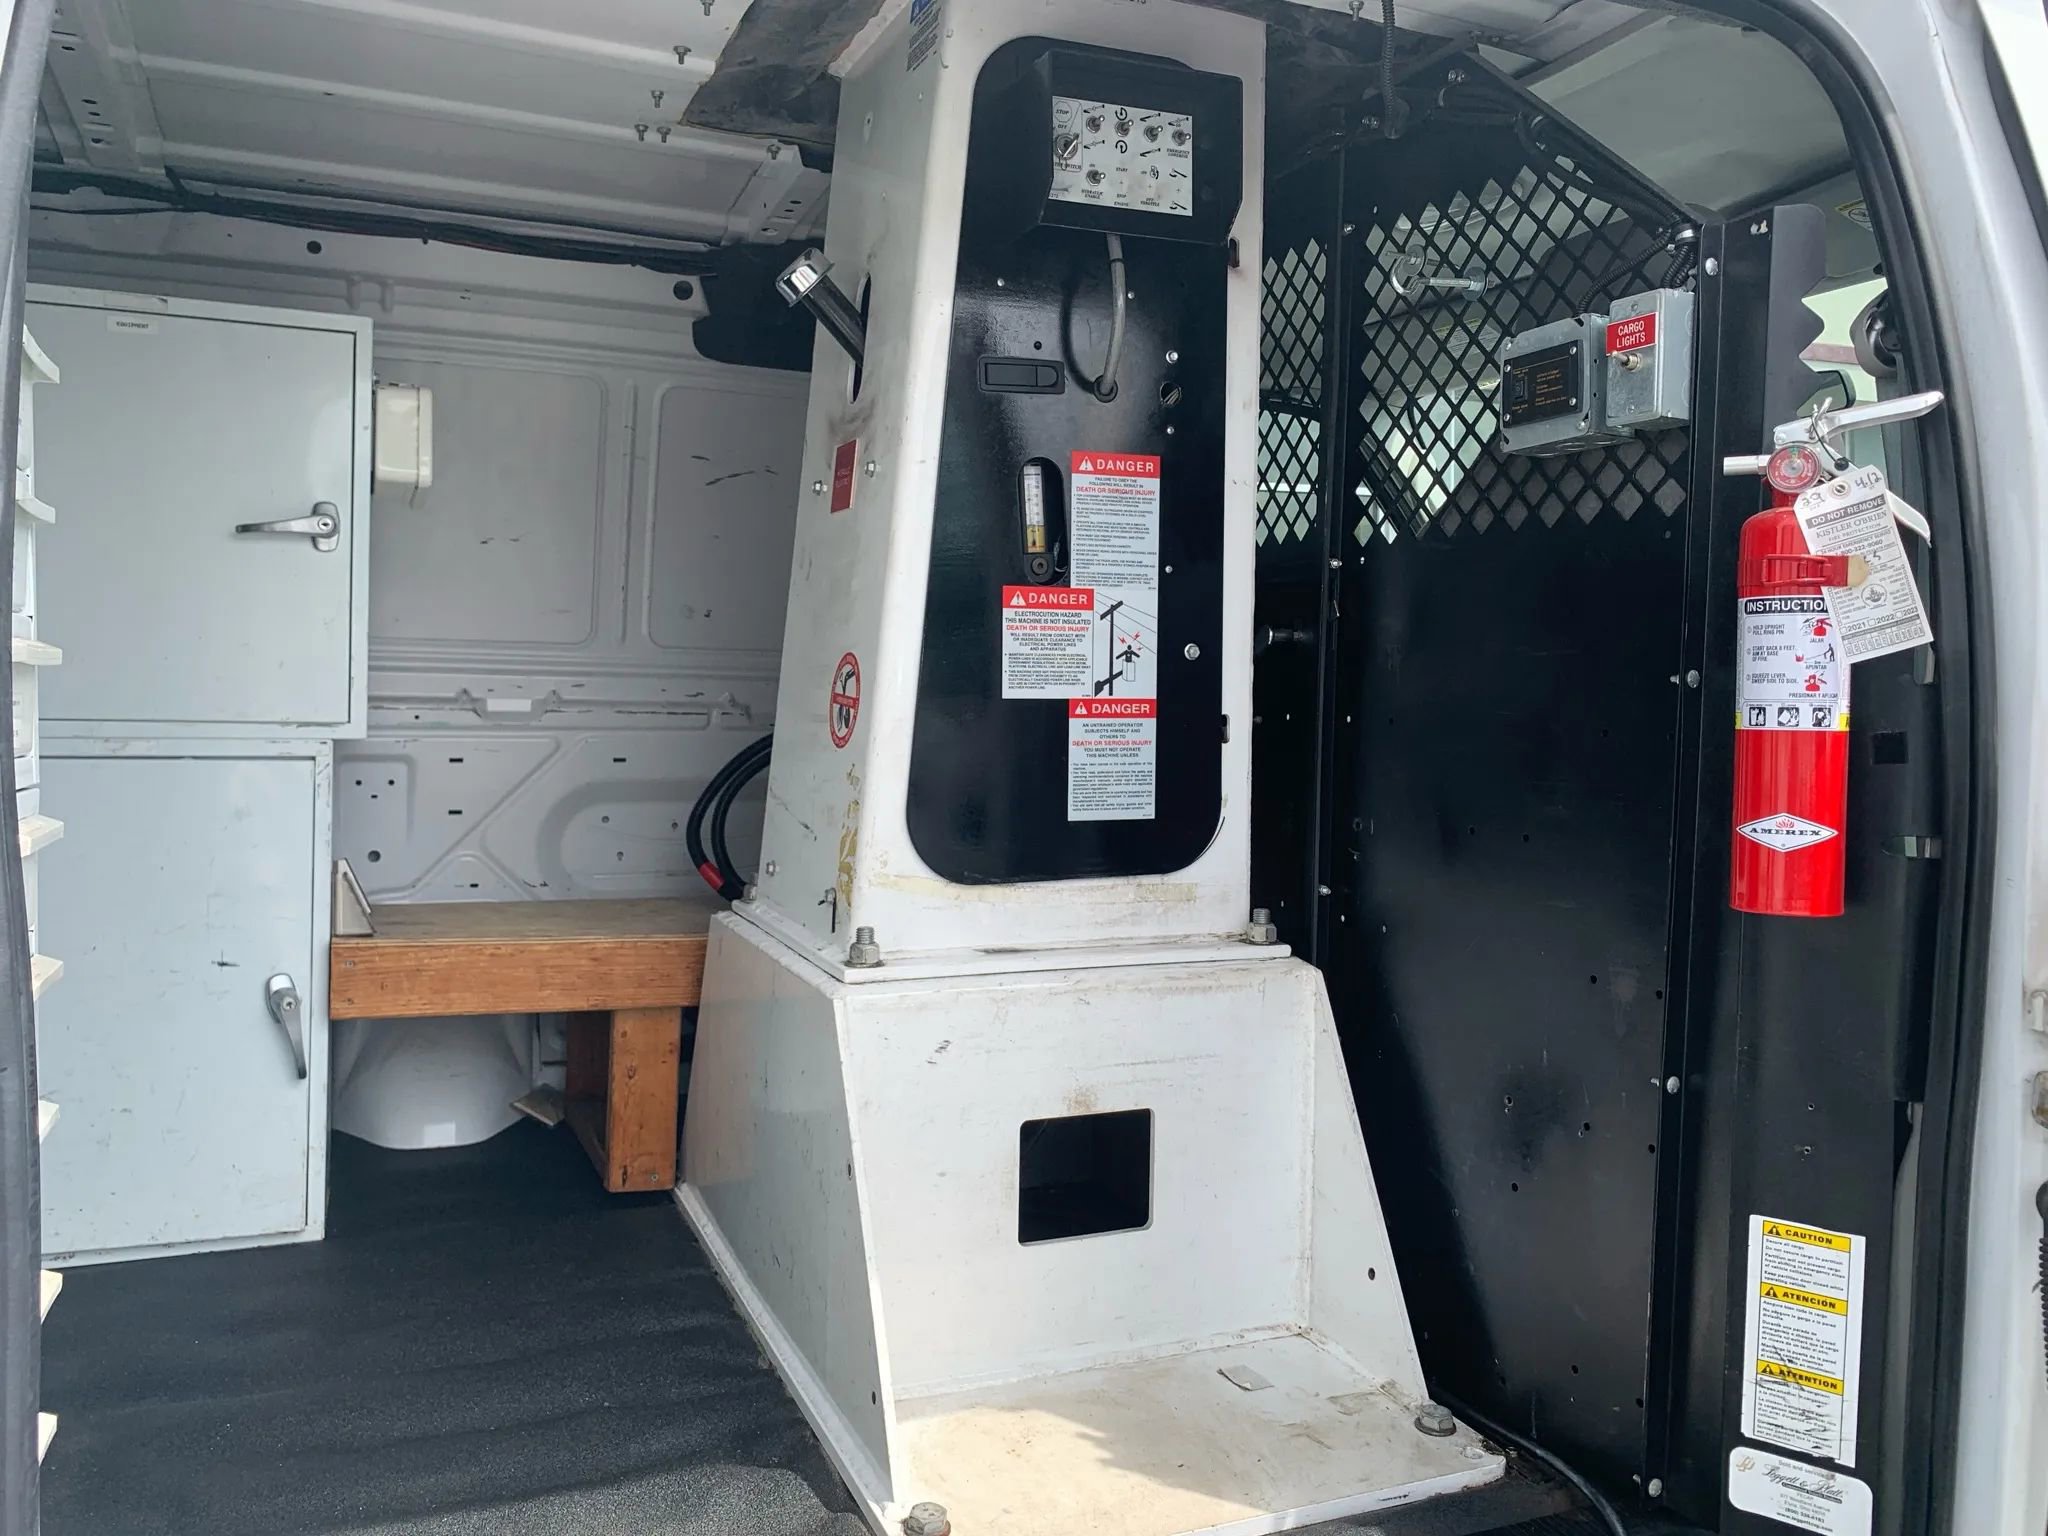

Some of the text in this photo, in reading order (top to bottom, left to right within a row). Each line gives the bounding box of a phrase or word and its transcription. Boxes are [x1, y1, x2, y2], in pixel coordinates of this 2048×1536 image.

[1617, 320, 1645, 336] CARGO
[1616, 332, 1646, 348] LIGHTS
[1096, 458, 1154, 473] DANGER
[1811, 498, 1885, 526] DO NOT REMOVE
[1816, 522, 1852, 539] KISTLER
[1028, 592, 1088, 605] DANGER
[1747, 599, 1828, 612] INSTRUCTIO
[1061, 618, 1091, 626] INSULATED
[1848, 607, 1919, 632] 2021 2022 2023
[1091, 703, 1150, 714] DANGER
[1749, 827, 1822, 836] AMEREX
[1785, 1229, 1833, 1245] CAUTION
[1765, 1252, 1786, 1260] Partition
[1807, 1261, 1826, 1269] prevent
[1771, 1265, 1788, 1273] vehicle
[1778, 1261, 1796, 1269] shifting
[1803, 1266, 1830, 1276] emergency
[1764, 1270, 1776, 1278] Keep
[1778, 1273, 1799, 1281] partition
[1813, 1280, 1828, 1288] closed
[1764, 1277, 1787, 1286] operating
[1799, 1480, 1808, 1488] &
